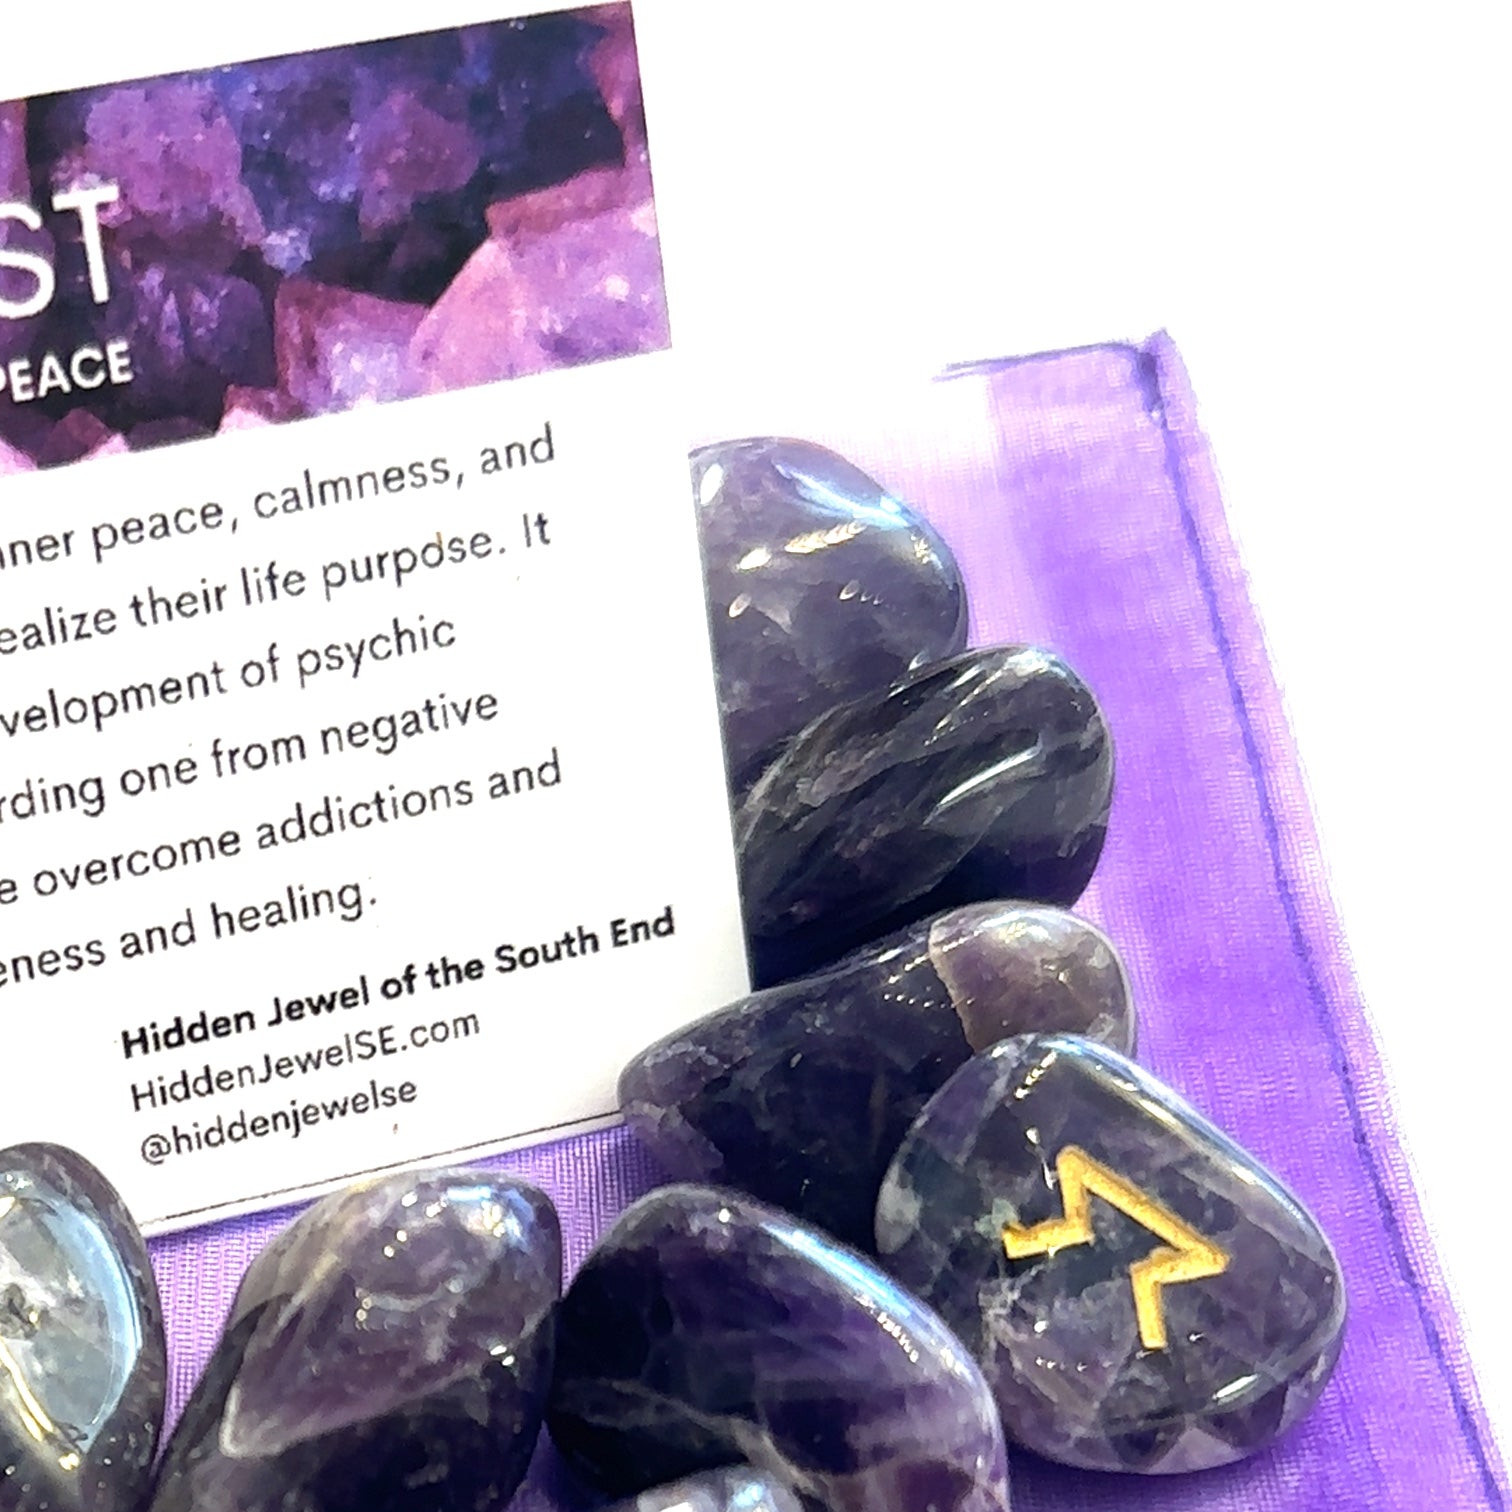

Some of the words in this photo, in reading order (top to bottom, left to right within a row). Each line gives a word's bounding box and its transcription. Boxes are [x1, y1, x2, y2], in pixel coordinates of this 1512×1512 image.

[91, 502, 238, 565] peace,
[253, 457, 464, 519] calmness,
[480, 420, 555, 475] and
[128, 577, 228, 628] their
[240, 560, 307, 607] life
[321, 529, 506, 603] purpose.
[522, 512, 551, 549] It
[239, 641, 280, 689] of
[296, 614, 456, 690] psychic
[119, 757, 199, 797] one
[210, 733, 307, 779] from
[320, 692, 499, 757] negative
[32, 830, 242, 897] overcome
[256, 779, 474, 850] addictions
[487, 746, 562, 800] and
[119, 907, 197, 960] and
[209, 882, 377, 940] healing.
[120, 1009, 257, 1060] Hidden
[266, 974, 370, 1028] Jewel
[379, 962, 418, 1001] of
[424, 955, 486, 990] the
[493, 924, 601, 975] South
[609, 904, 676, 949] End
[130, 1013, 481, 1113] HiddenJewelSE.com
[140, 1079, 418, 1167] @hiddenjewelse
